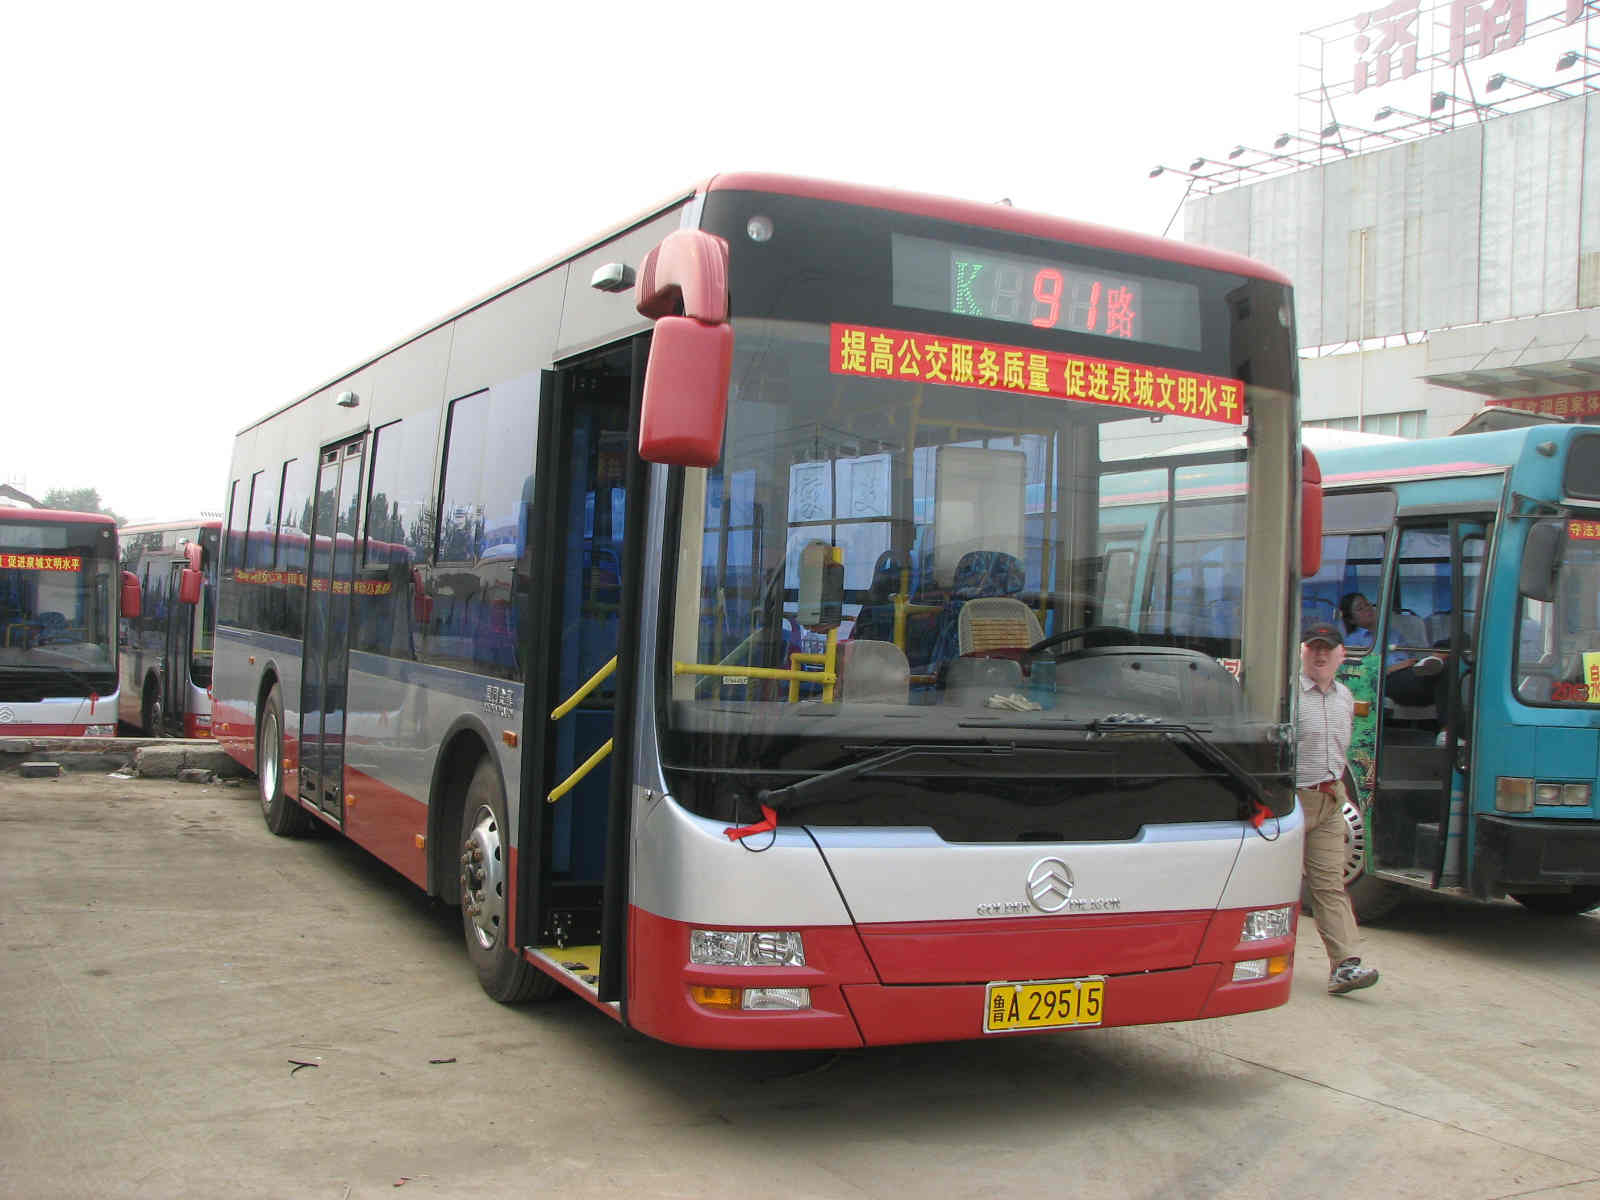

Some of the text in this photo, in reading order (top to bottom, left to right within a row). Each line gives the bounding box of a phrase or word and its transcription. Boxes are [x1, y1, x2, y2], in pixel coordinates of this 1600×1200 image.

[839, 329, 1241, 421] 提高公交服务质量 促进泉城文明水平
